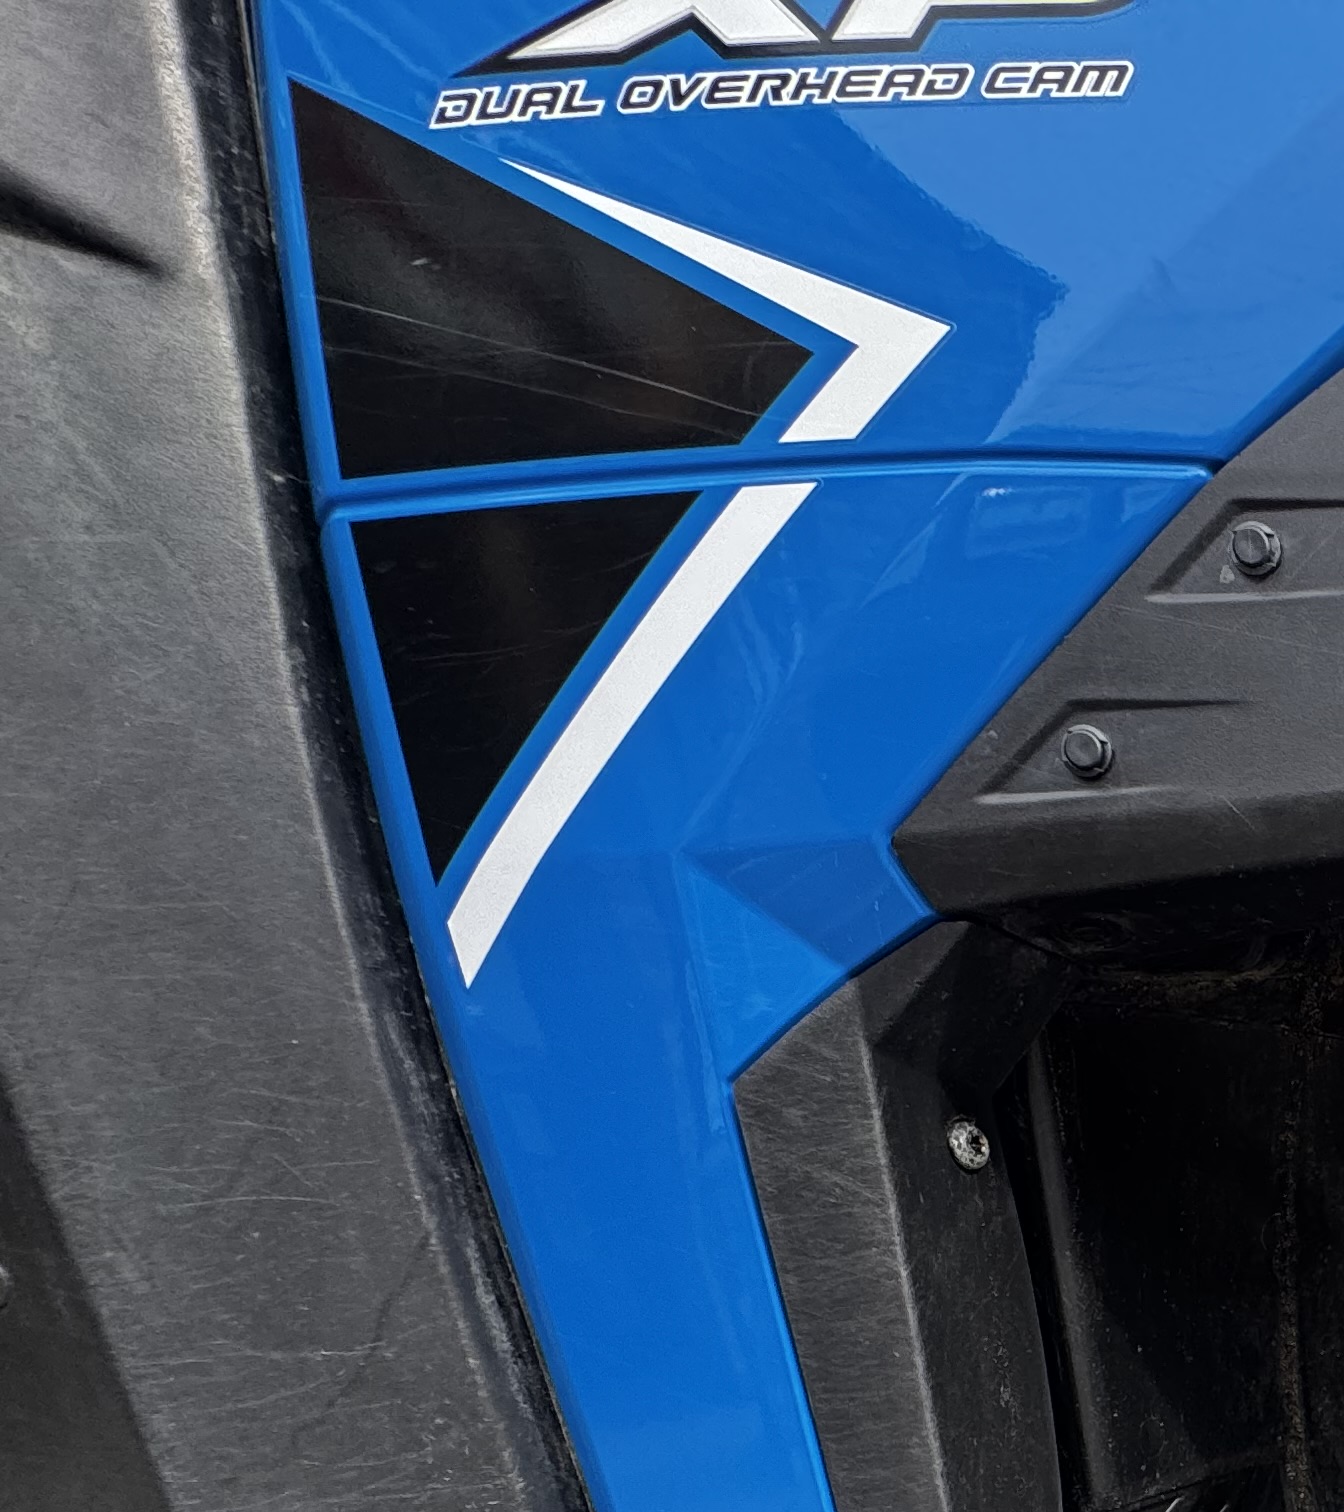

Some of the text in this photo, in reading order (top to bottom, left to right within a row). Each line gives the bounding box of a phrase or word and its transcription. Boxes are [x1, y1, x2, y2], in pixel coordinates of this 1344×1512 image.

[430, 60, 1134, 129] DUAL OVERHEAD CAM
